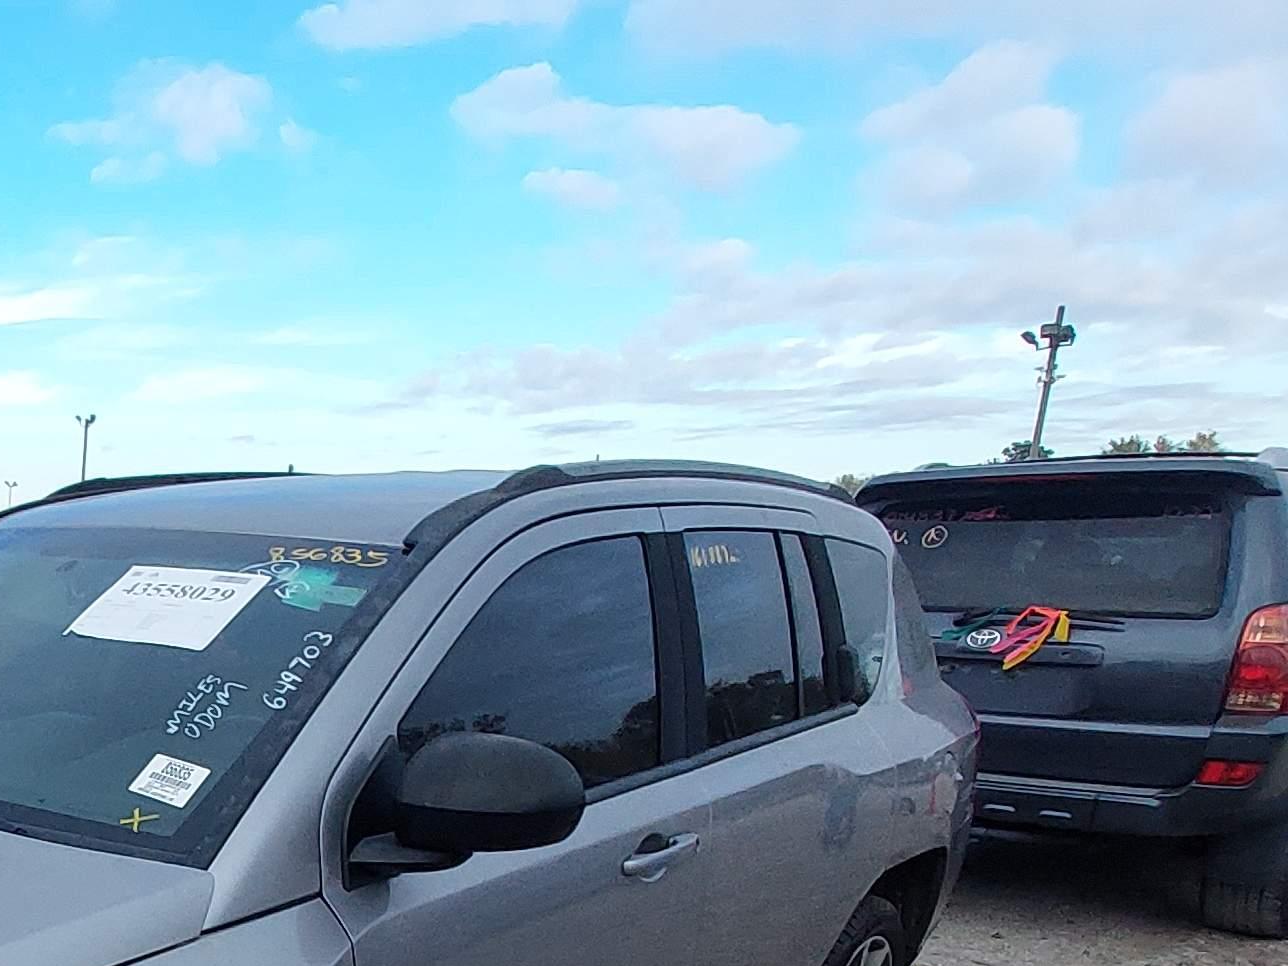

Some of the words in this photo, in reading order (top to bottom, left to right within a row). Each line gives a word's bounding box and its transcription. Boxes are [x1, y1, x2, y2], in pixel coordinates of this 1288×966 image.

[123, 582, 236, 602] 43558029
[263, 631, 333, 709] 649703
[184, 682, 248, 738] ODOM
